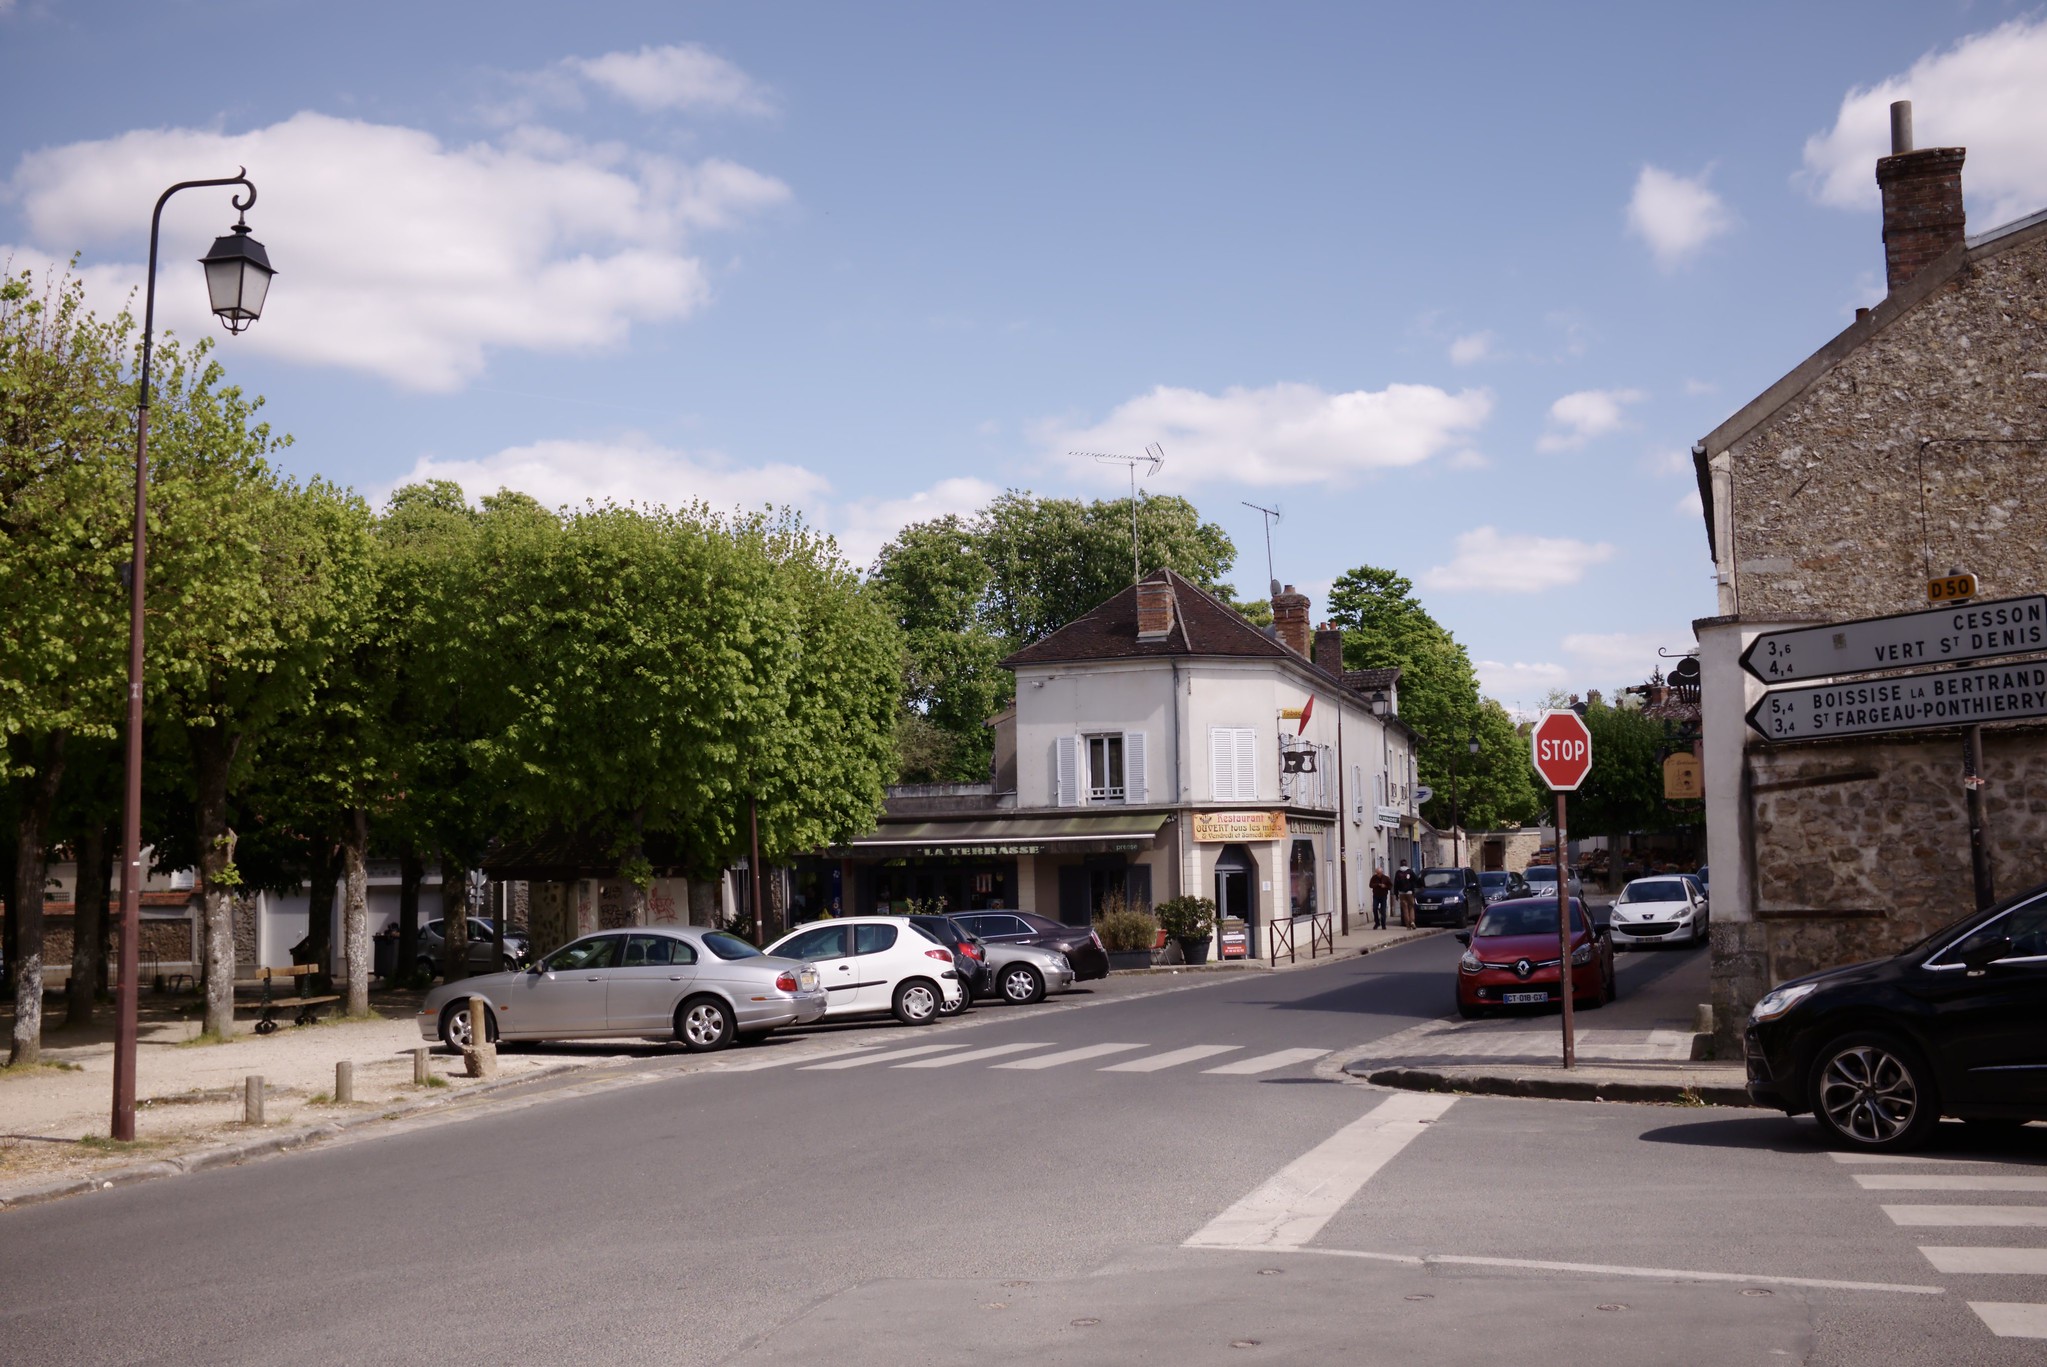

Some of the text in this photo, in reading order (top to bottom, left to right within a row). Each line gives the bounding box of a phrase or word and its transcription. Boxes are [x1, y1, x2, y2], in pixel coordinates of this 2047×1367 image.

[1931, 579, 1969, 598] D 50
[1953, 604, 2040, 631] CESSON
[1768, 641, 1791, 657] 3,6
[1875, 641, 1925, 663] VERT
[1972, 626, 2041, 650] DENIS
[1769, 660, 1793, 676] 4,4
[1813, 669, 2046, 709] BOISSISE LA BERTRAND
[1772, 699, 1794, 715] 5,4
[1835, 691, 2047, 727] FARGEAU-PONTHIERRY
[1774, 718, 1795, 735] 3,4
[1540, 739, 1585, 762] STOP
[1196, 824, 1229, 832] OUVERT
[1231, 824, 1247, 832] tous
[1249, 823, 1260, 831] les
[1217, 814, 1264, 823] Restaurant
